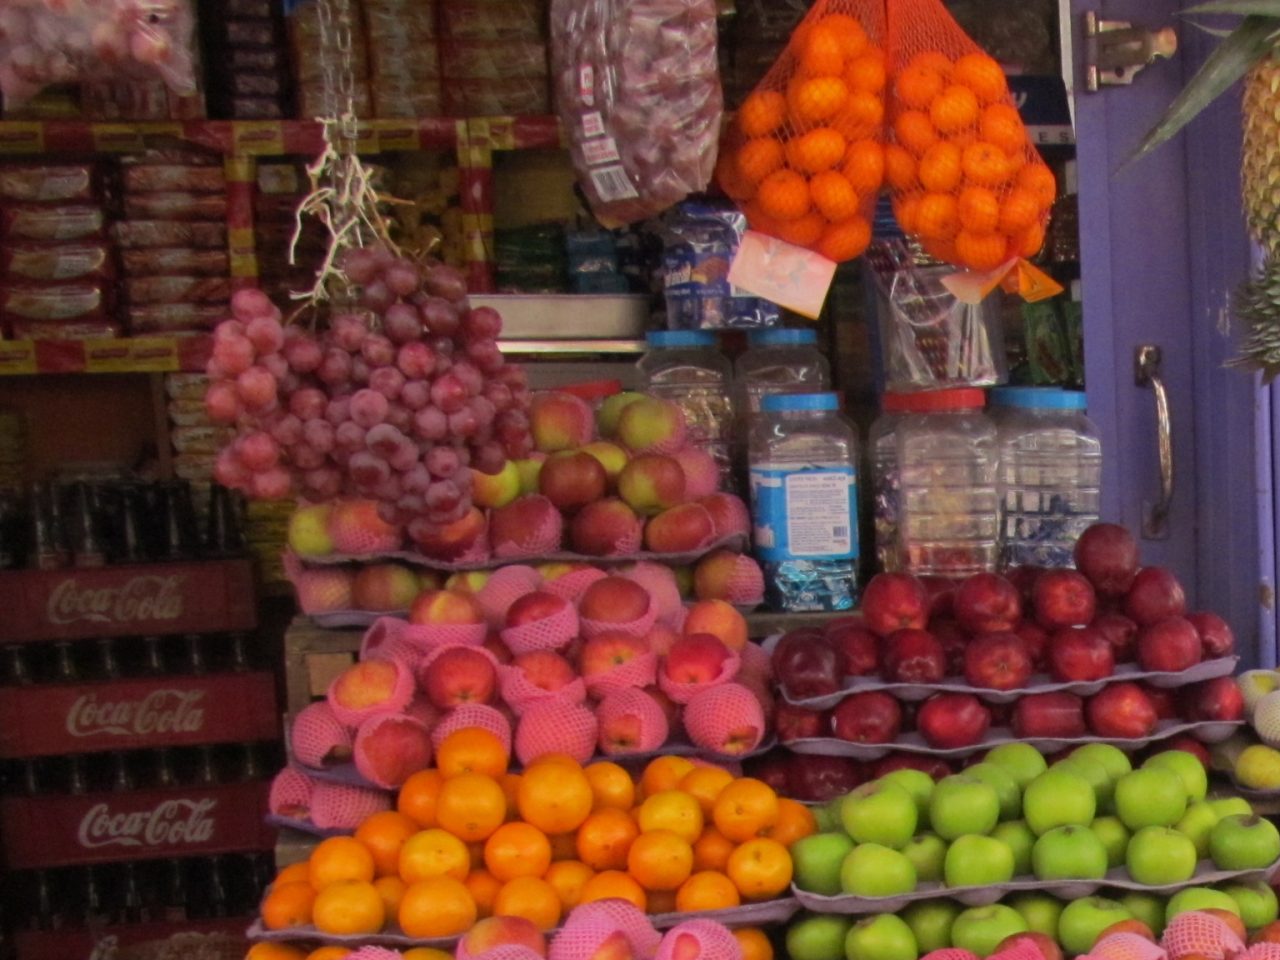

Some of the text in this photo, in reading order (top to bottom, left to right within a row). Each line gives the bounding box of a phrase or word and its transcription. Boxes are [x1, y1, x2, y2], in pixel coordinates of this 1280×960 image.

[47, 574, 187, 625] Coca-Cola
[66, 688, 208, 737] Coca-Cola
[78, 798, 218, 848] Coca-Cola
